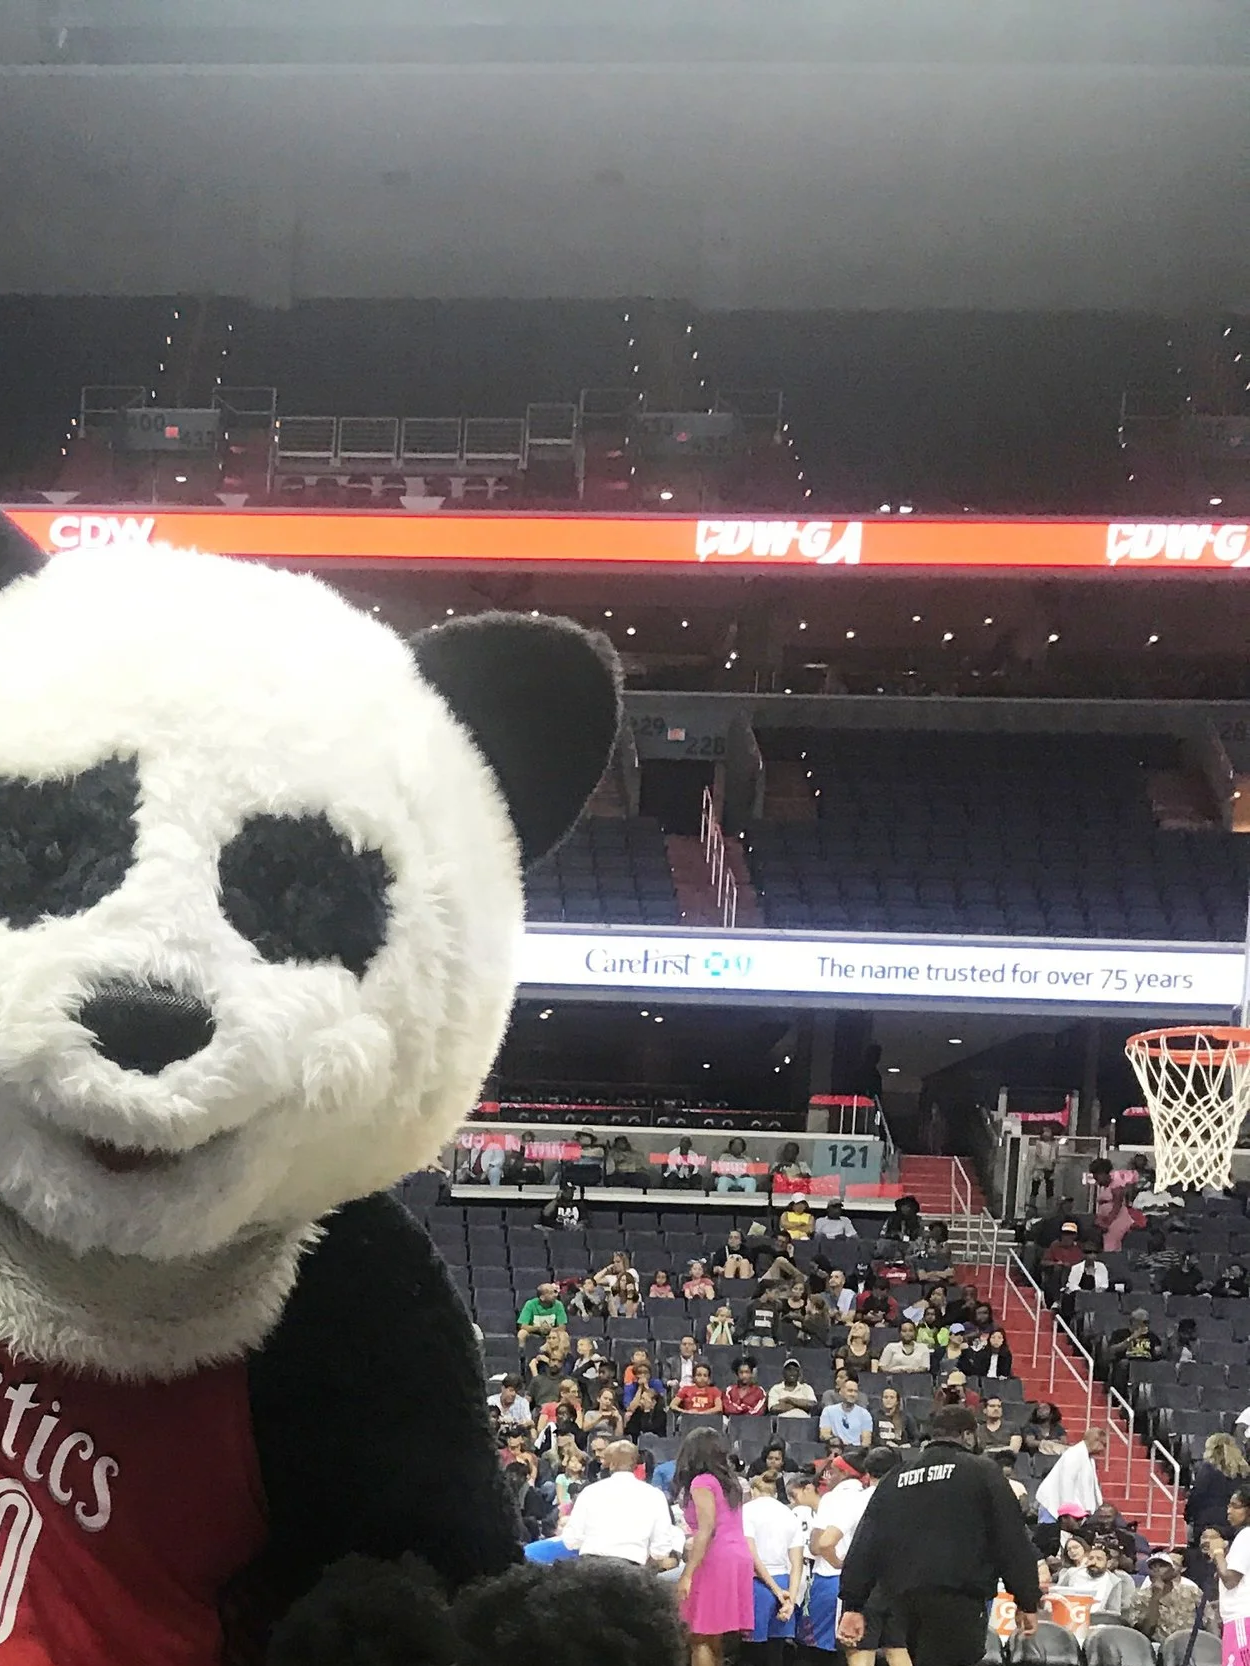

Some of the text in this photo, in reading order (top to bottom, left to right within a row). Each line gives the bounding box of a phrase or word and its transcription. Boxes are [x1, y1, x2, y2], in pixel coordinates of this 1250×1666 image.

[49, 515, 155, 549] CDW
[817, 956, 1193, 993] The name trusted for over 75 years
[828, 1144, 869, 1169] 121
[897, 1463, 956, 1488] EVENT STAFF
[999, 1601, 1018, 1619] G
[1070, 1605, 1087, 1623] G
